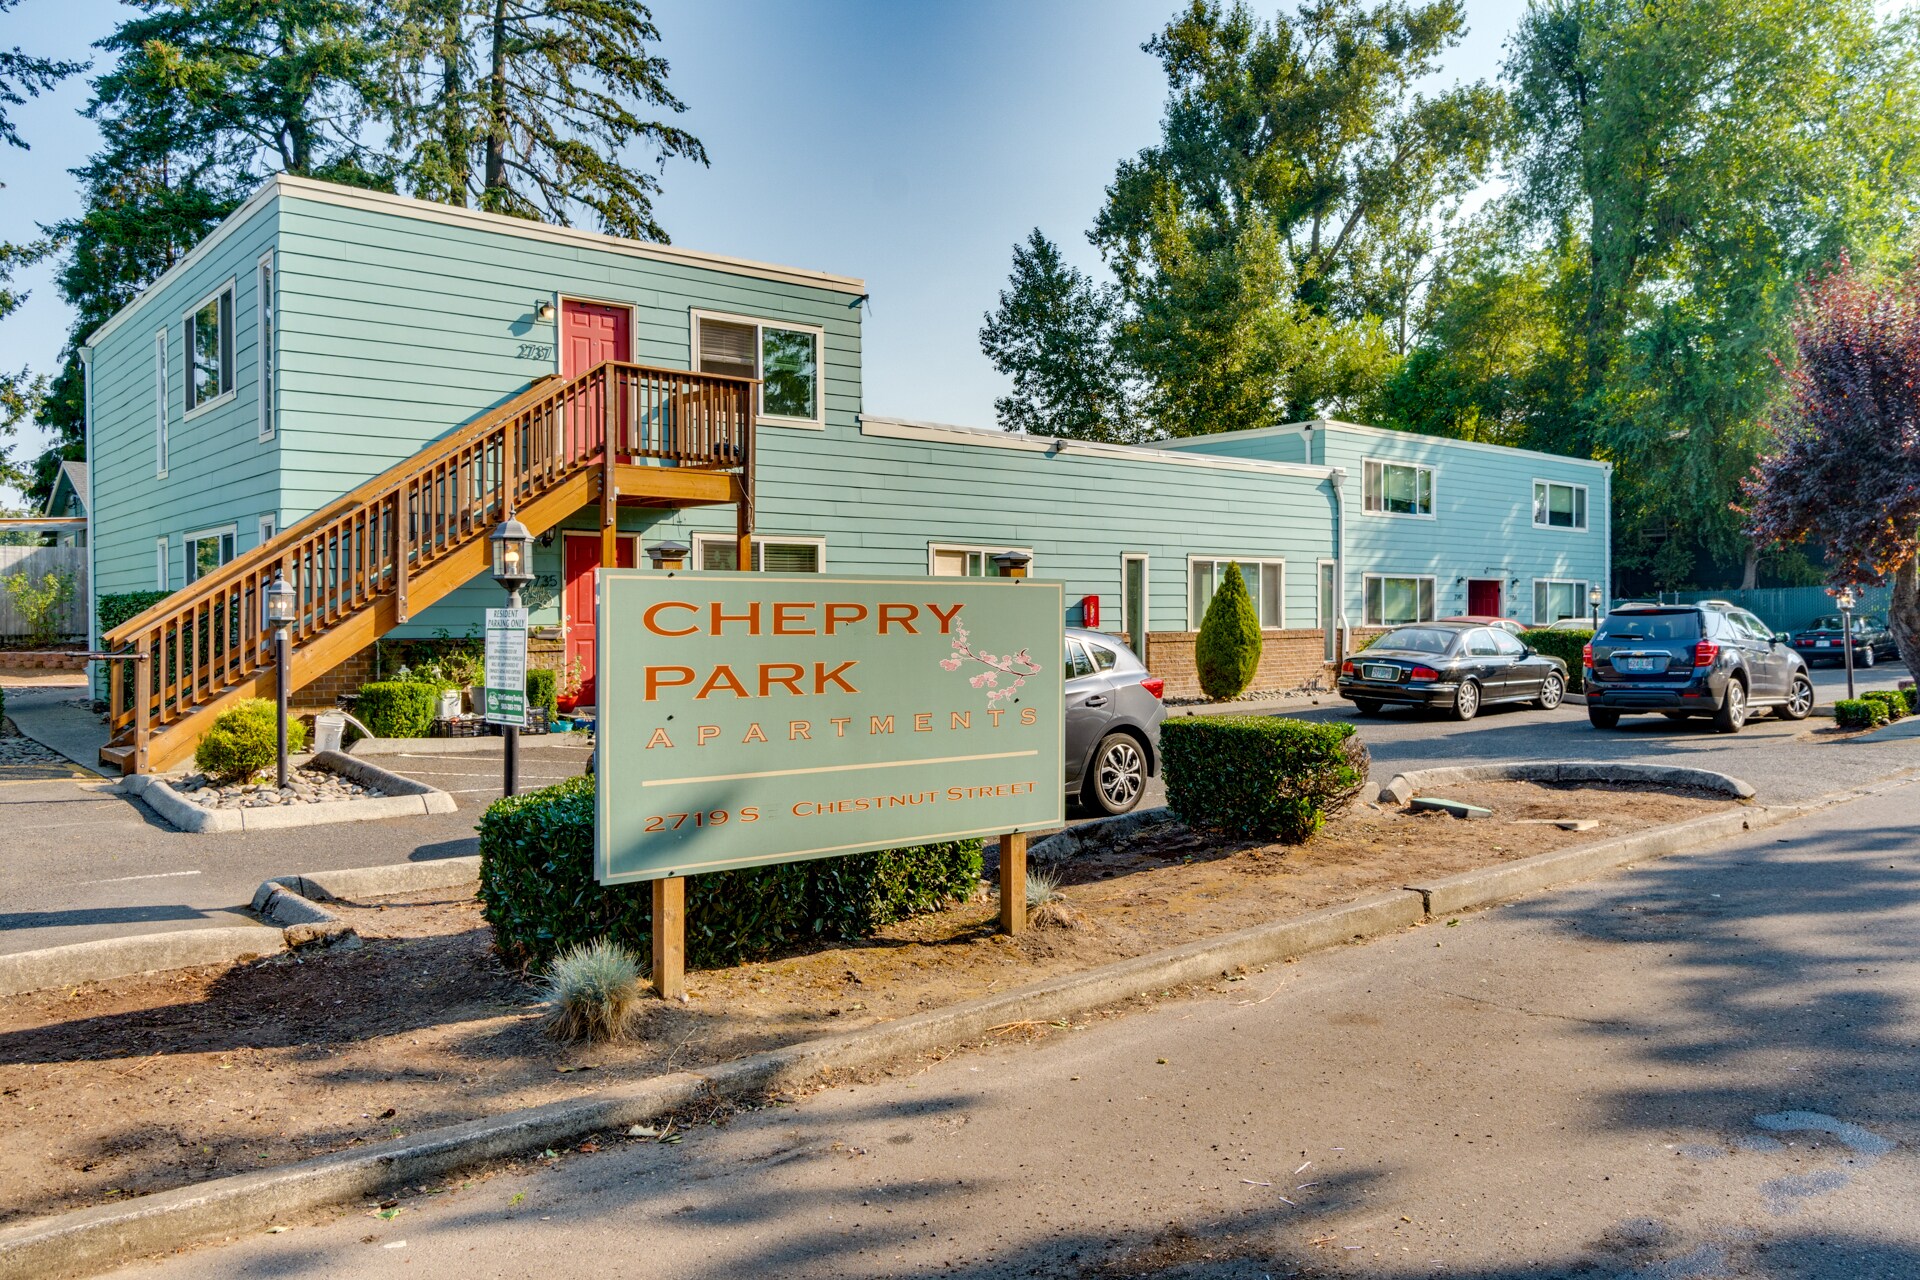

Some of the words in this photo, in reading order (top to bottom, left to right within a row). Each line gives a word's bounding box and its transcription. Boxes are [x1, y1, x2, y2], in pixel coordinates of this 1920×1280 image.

[517, 343, 552, 360] 2737
[487, 619, 510, 628] PARKING
[510, 619, 526, 628] ONLY
[493, 609, 518, 618] RESIDENT
[642, 660, 861, 702] PARK
[645, 707, 1037, 749] APARTMENTS
[643, 809, 729, 833] 2719
[739, 806, 760, 823] S
[791, 790, 940, 817] CHESTNUT
[945, 780, 1038, 801] STREET
